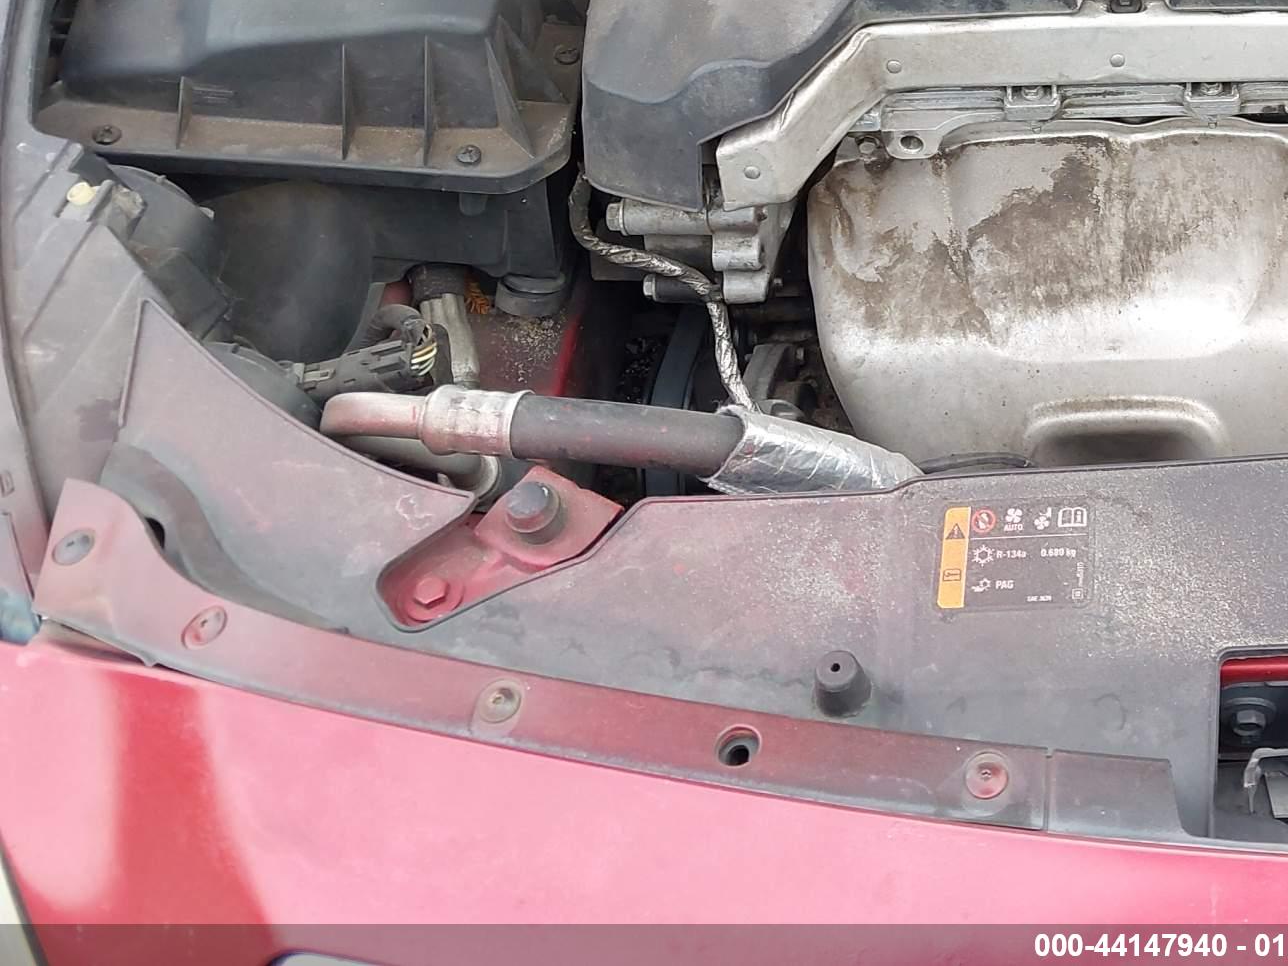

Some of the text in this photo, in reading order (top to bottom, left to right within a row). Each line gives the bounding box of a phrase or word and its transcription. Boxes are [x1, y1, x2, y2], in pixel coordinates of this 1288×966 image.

[1003, 523, 1024, 532] AUTO
[995, 548, 1027, 559] R-134a
[1066, 547, 1077, 559] kg
[995, 579, 1015, 590] PAG
